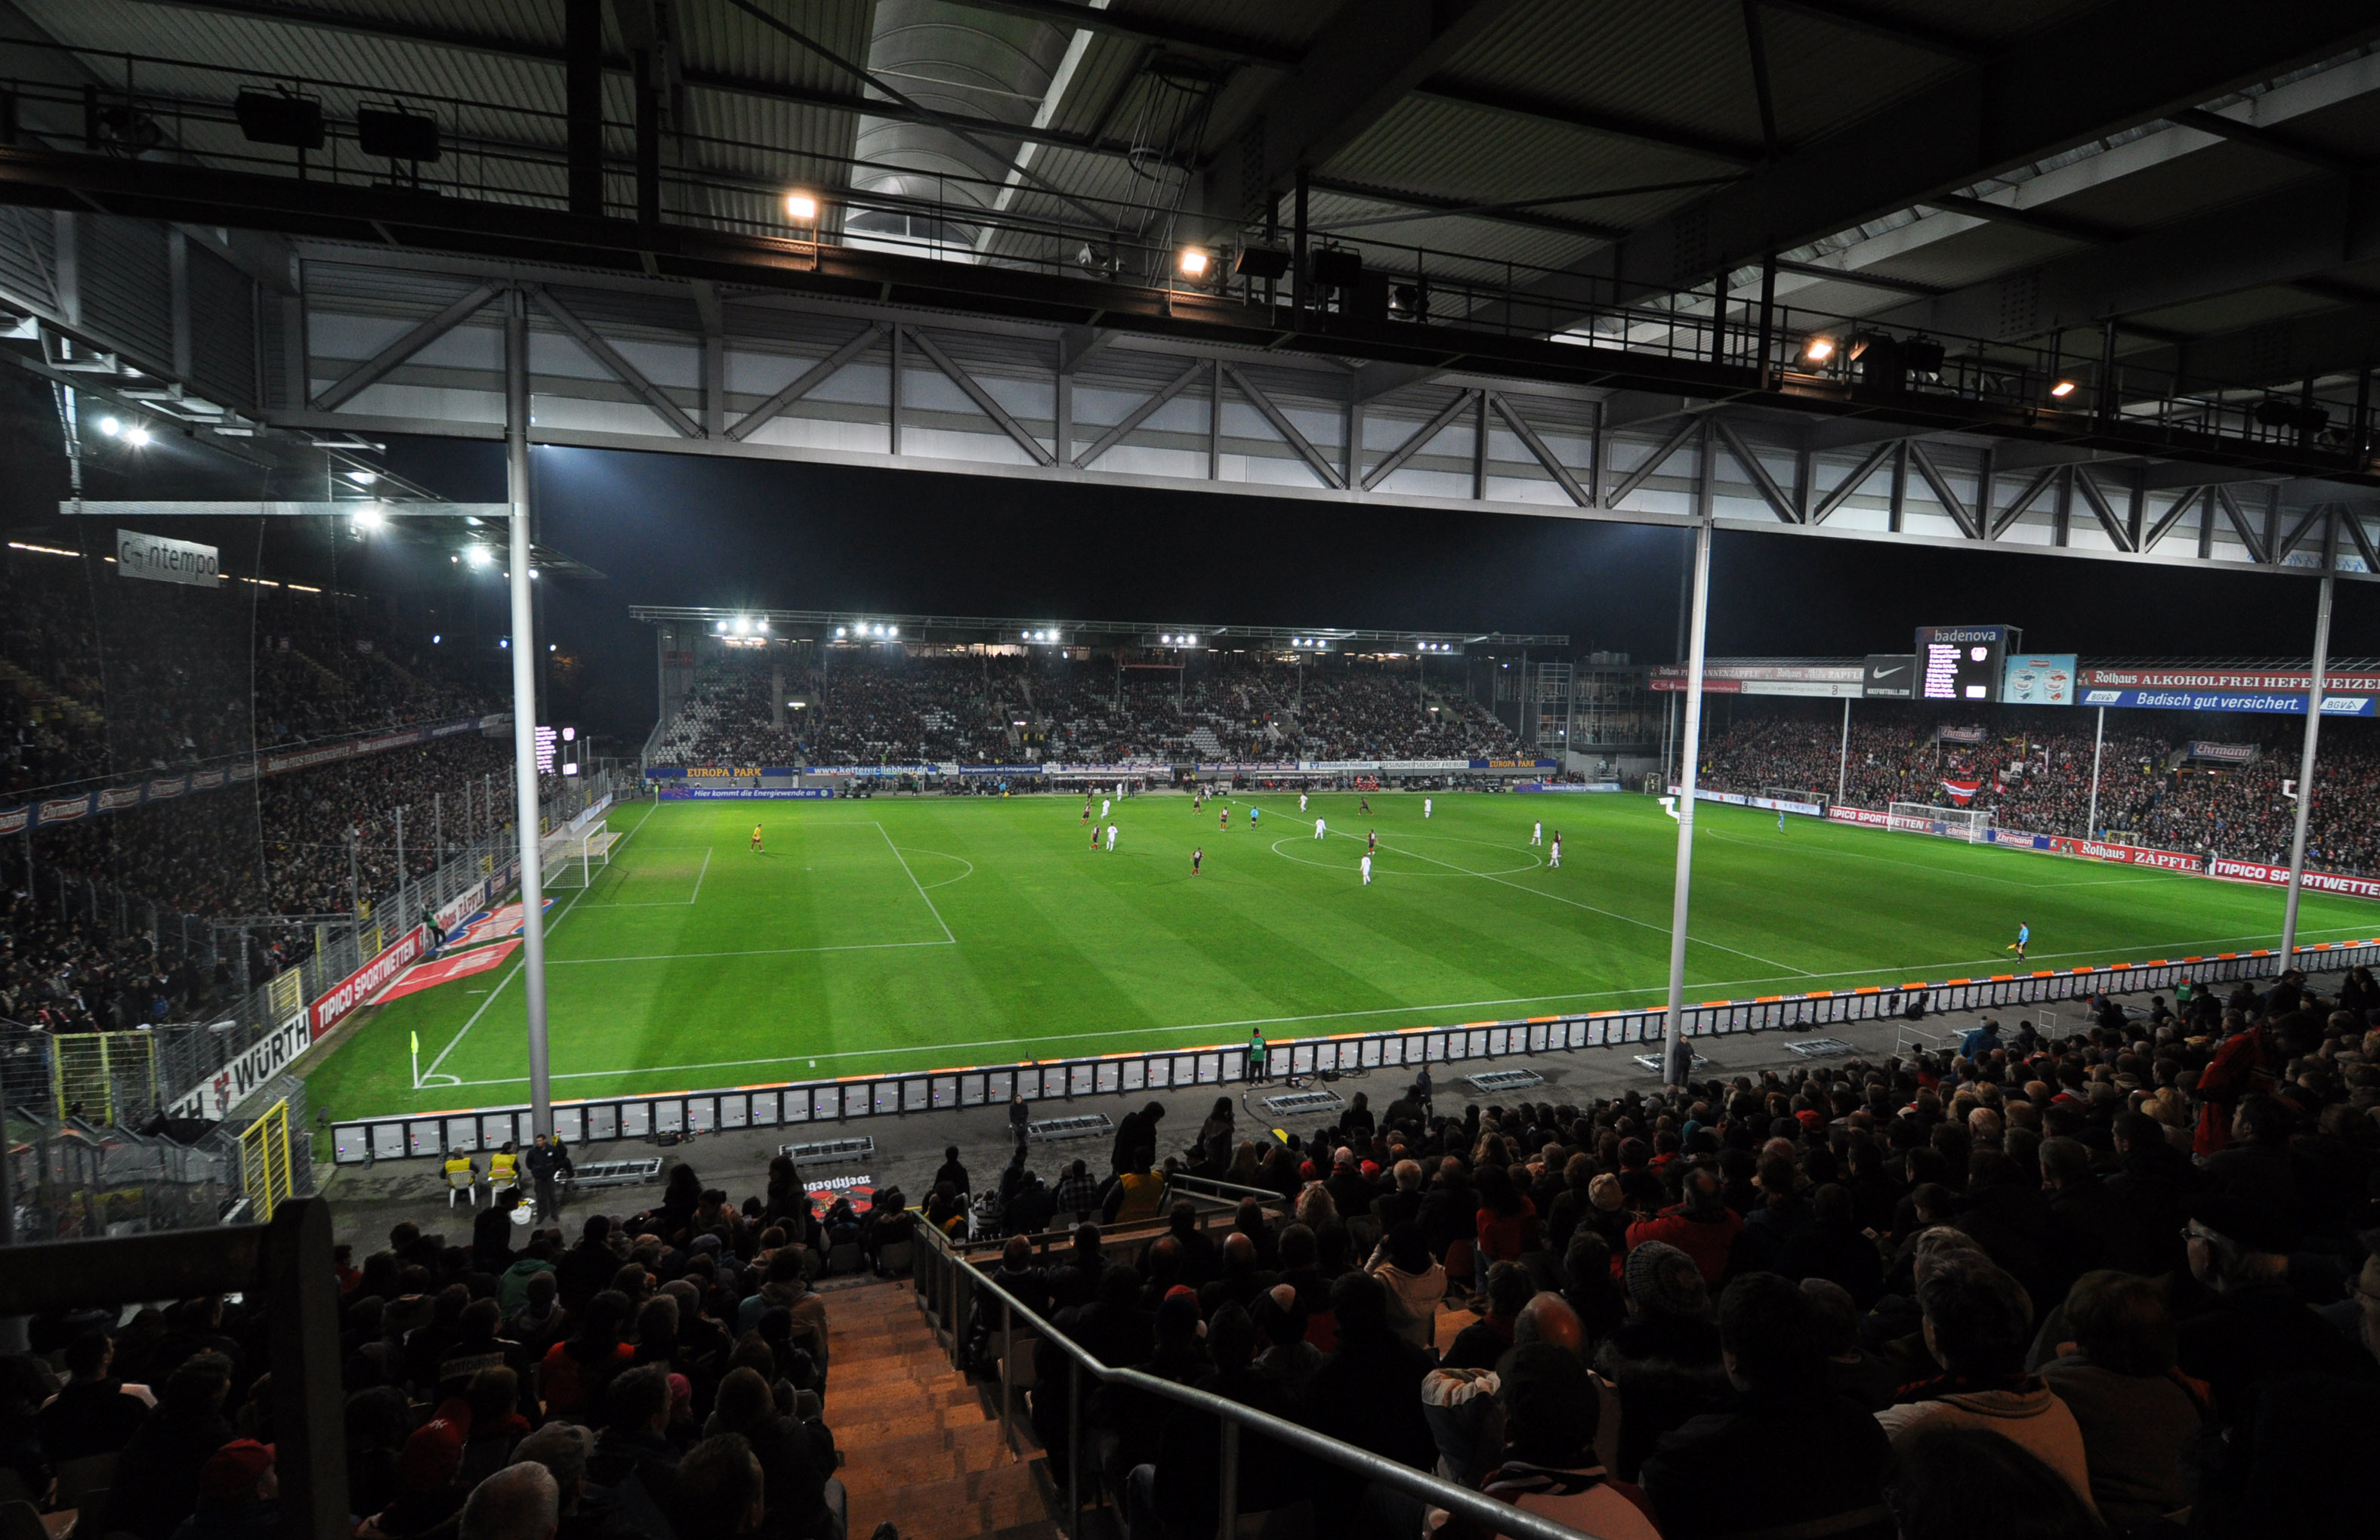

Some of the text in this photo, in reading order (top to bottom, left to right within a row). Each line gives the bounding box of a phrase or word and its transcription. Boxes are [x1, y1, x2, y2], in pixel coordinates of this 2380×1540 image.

[1934, 629, 1996, 642] badenova
[2141, 675, 2260, 688] ALKOHOLFREI
[2136, 692, 2300, 711] Badisch gut versichert.
[2196, 743, 2252, 758] Ehrmann
[814, 766, 929, 774] www.ketterer-liebherr.de
[1489, 759, 1536, 768] EUROPA PARK
[687, 767, 762, 777] EUROPA PARK
[754, 789, 805, 798] Energiewende
[1829, 807, 1925, 830] TIPICO SPORTWETTEN
[1996, 832, 2033, 846] Ehrmann
[2080, 841, 2126, 859] Rothaus
[2135, 850, 2203, 872] ZÄPFLE
[2217, 861, 2380, 897] TIPICO SPRTWETTE
[458, 887, 485, 922] ZÄPFLE
[317, 984, 353, 1029] TIPICO
[353, 936, 415, 1001] SPORTWETTEN
[233, 1013, 309, 1096] WÜRTH
